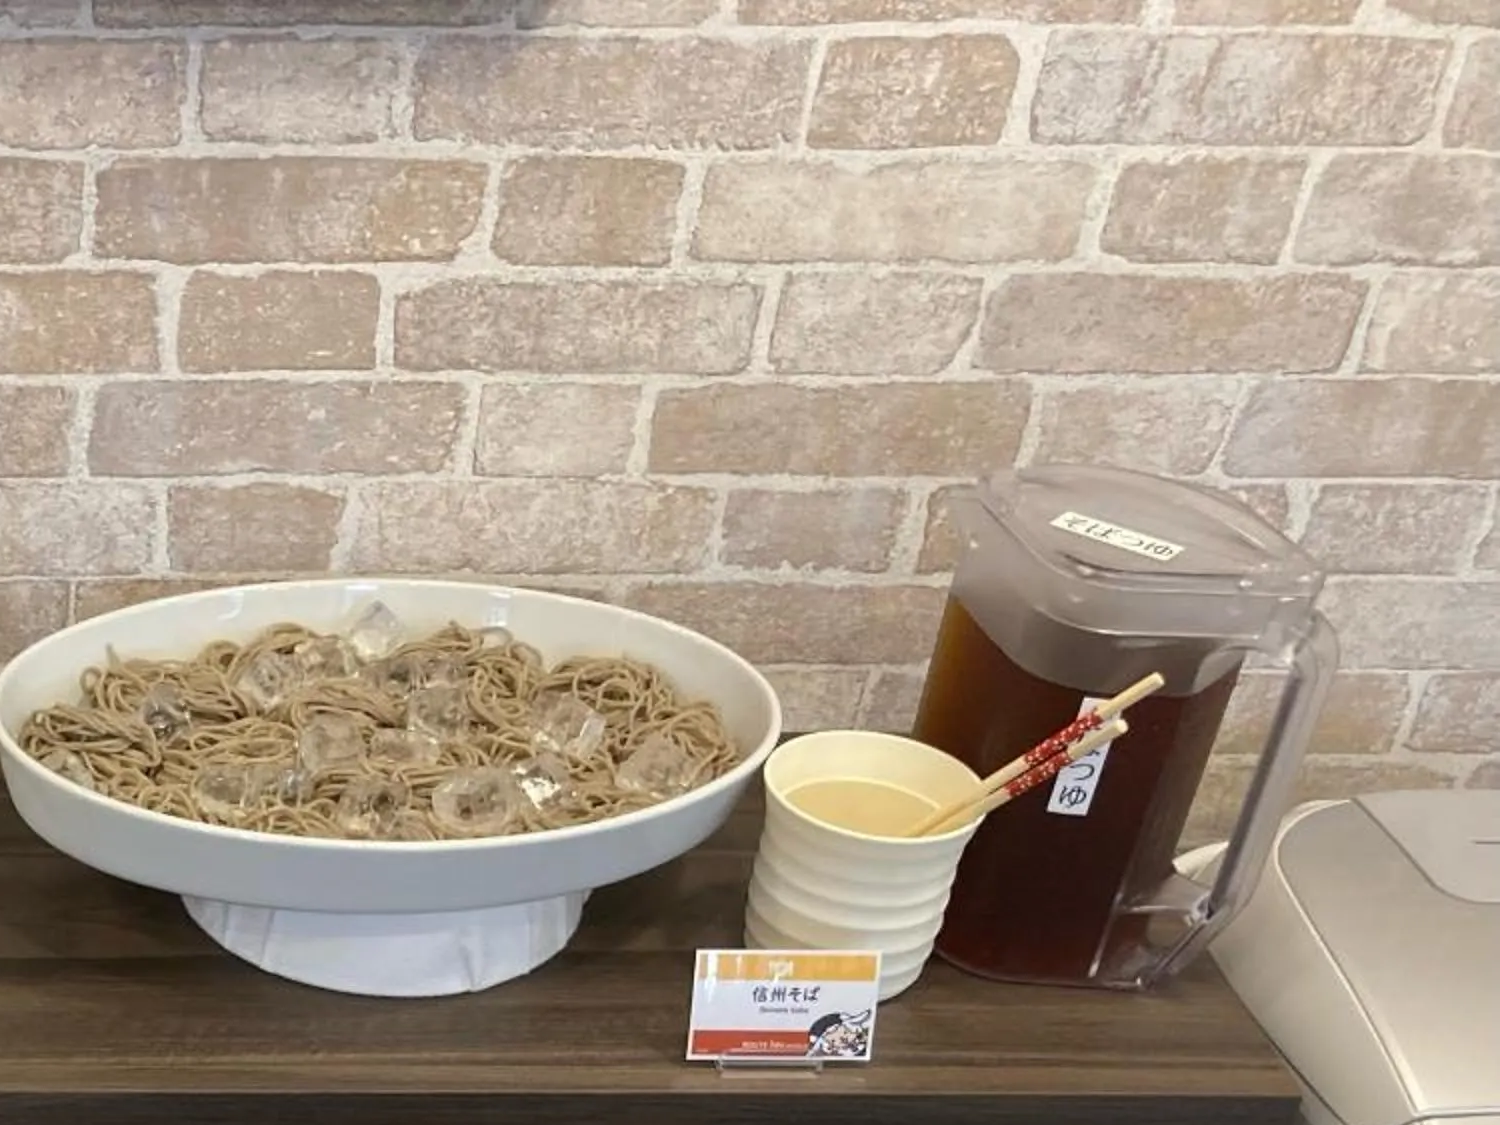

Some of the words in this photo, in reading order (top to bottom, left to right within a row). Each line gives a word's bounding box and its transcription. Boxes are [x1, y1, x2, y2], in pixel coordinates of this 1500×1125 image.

[1063, 514, 1174, 559] そばつゆ
[752, 985, 821, 1003] 信州そば
